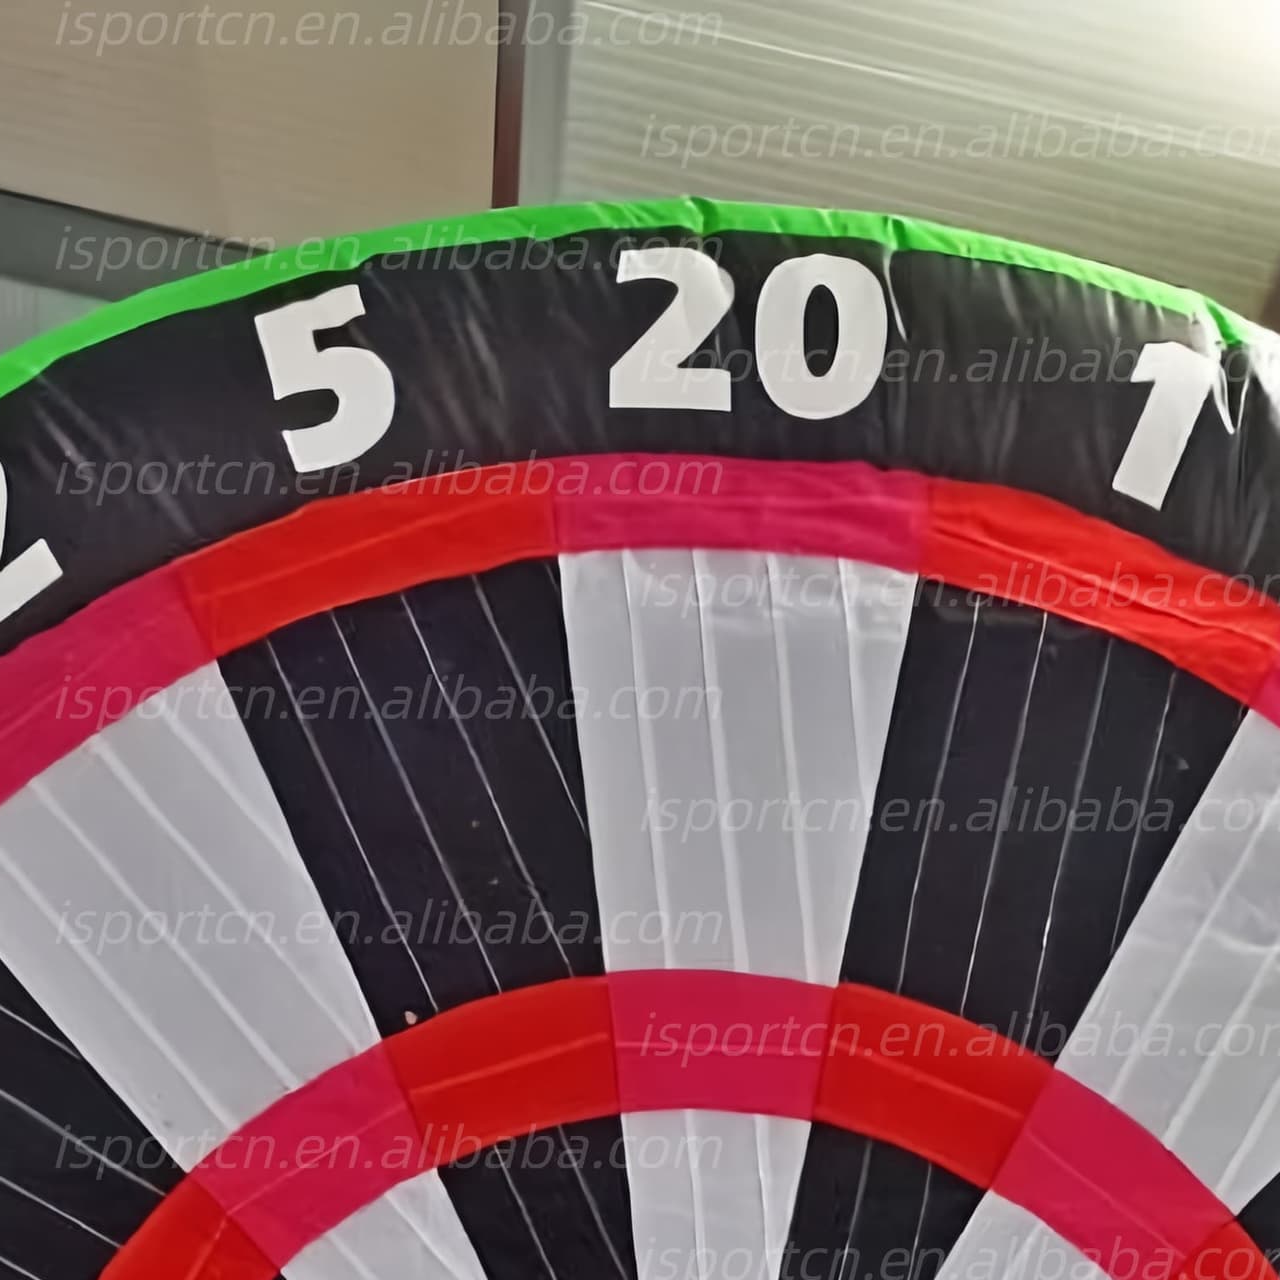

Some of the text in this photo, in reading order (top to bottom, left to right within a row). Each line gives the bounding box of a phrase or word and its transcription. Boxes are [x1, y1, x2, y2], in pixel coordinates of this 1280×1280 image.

[255, 284, 395, 472] 5
[609, 247, 888, 419] 20
[1112, 341, 1217, 511] 1
